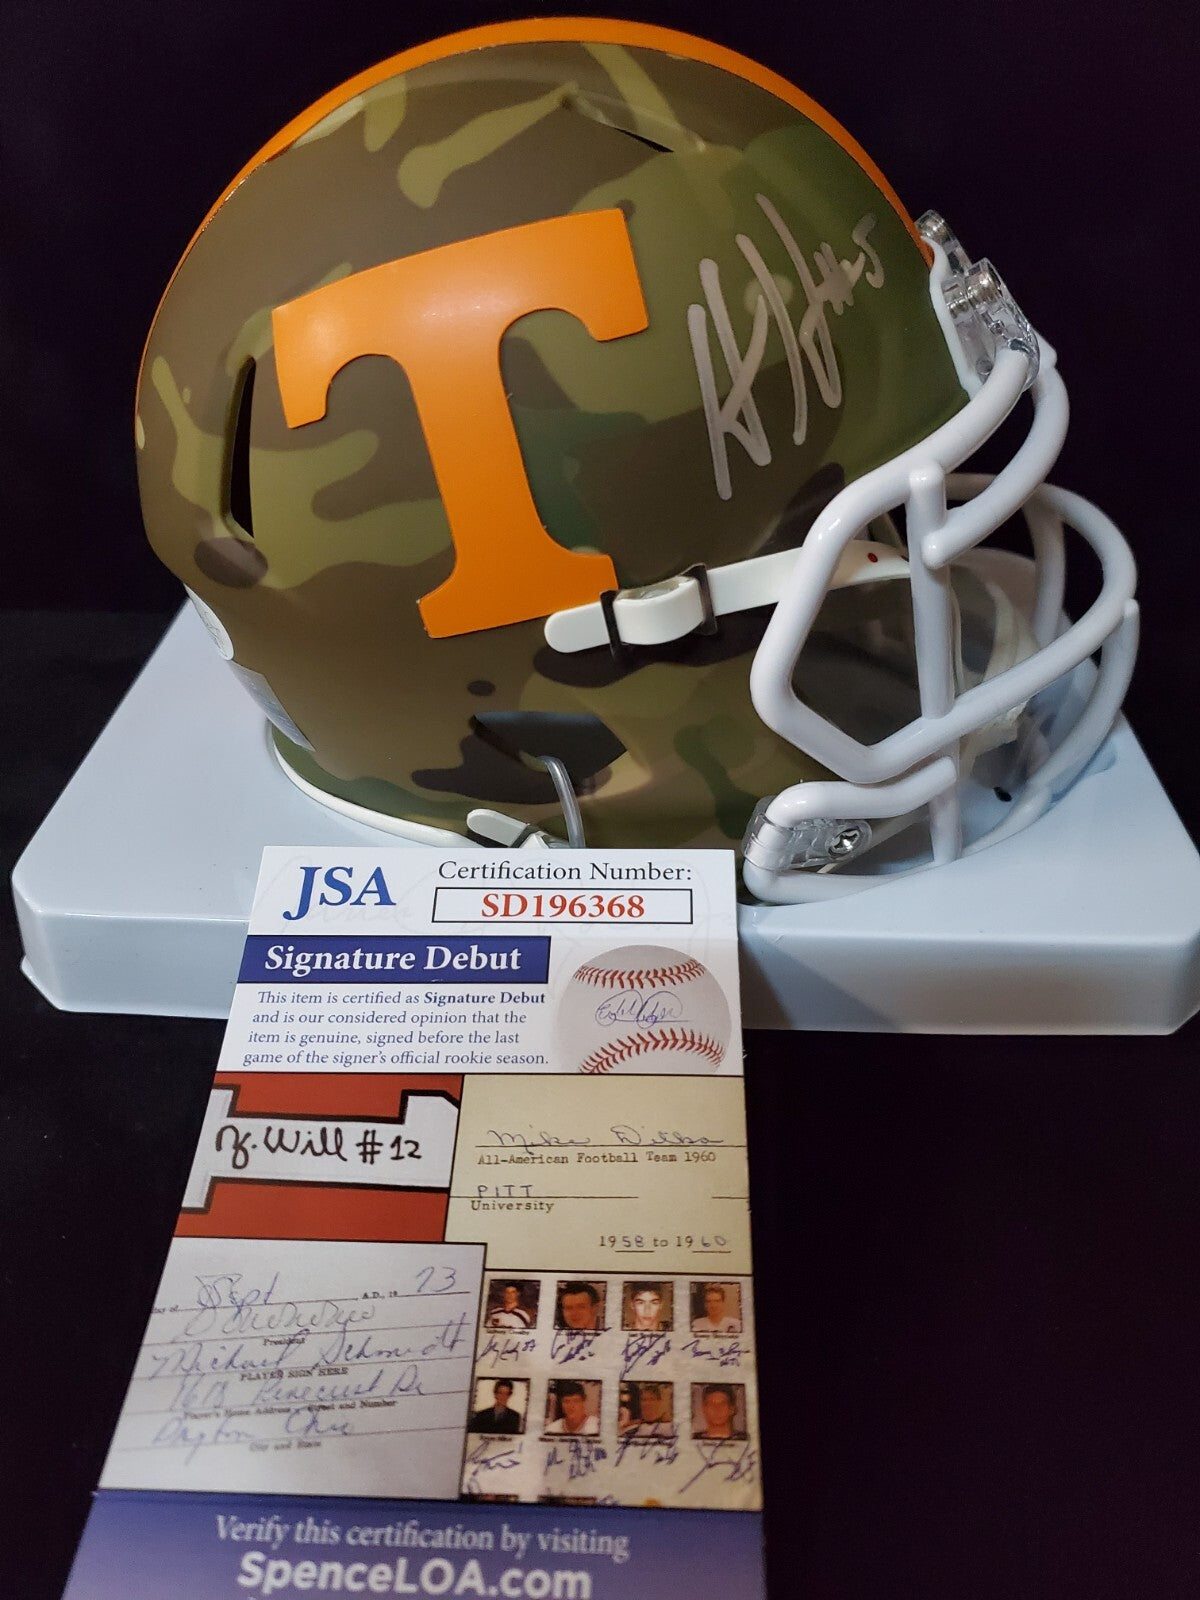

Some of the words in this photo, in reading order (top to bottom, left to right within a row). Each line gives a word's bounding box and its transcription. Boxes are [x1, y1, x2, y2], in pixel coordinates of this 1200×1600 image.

[438, 860, 582, 880] Certification
[589, 861, 692, 881] Number:
[282, 866, 397, 921] JSA
[480, 893, 645, 919] SD196368
[264, 945, 416, 978] Signature
[423, 945, 522, 971] Debut
[258, 991, 287, 1004] This
[290, 991, 322, 1004] item
[326, 991, 338, 1004] is
[342, 991, 401, 1004] certified
[405, 994, 420, 1004] as
[423, 991, 496, 1007] Signature
[500, 991, 546, 1004] Debut
[252, 1011, 279, 1024] and
[283, 1011, 294, 1024] is
[298, 1013, 324, 1024] our
[327, 1011, 407, 1024] considered
[410, 1011, 467, 1028] opinion
[471, 1011, 502, 1024] that
[504, 1011, 527, 1024] the
[248, 1031, 280, 1044] item
[285, 1031, 296, 1044] is
[299, 1031, 361, 1047] genuine,
[366, 1031, 414, 1047] signed
[417, 1031, 464, 1044] before
[468, 1031, 491, 1044] the
[495, 1031, 519, 1044] last
[242, 1054, 282, 1068] game
[286, 1050, 306, 1064] of
[306, 1051, 329, 1064] the
[390, 1050, 440, 1065] official
[444, 1051, 492, 1065] rookie
[495, 1053, 549, 1065] season.
[263, 1125, 348, 1162] Will
[477, 1152, 569, 1165] All-American
[576, 1151, 638, 1164] Football
[647, 1151, 677, 1163] Team
[684, 1151, 716, 1163] 1960
[477, 1184, 533, 1198] PITT
[470, 1200, 555, 1214] University
[652, 1236, 669, 1248] to
[215, 1514, 291, 1549] Verify
[293, 1516, 341, 1545] this
[345, 1519, 495, 1551] certification
[501, 1524, 532, 1559] by
[537, 1525, 630, 1563] visiting
[236, 1550, 593, 1599] SpenceLOA.com
